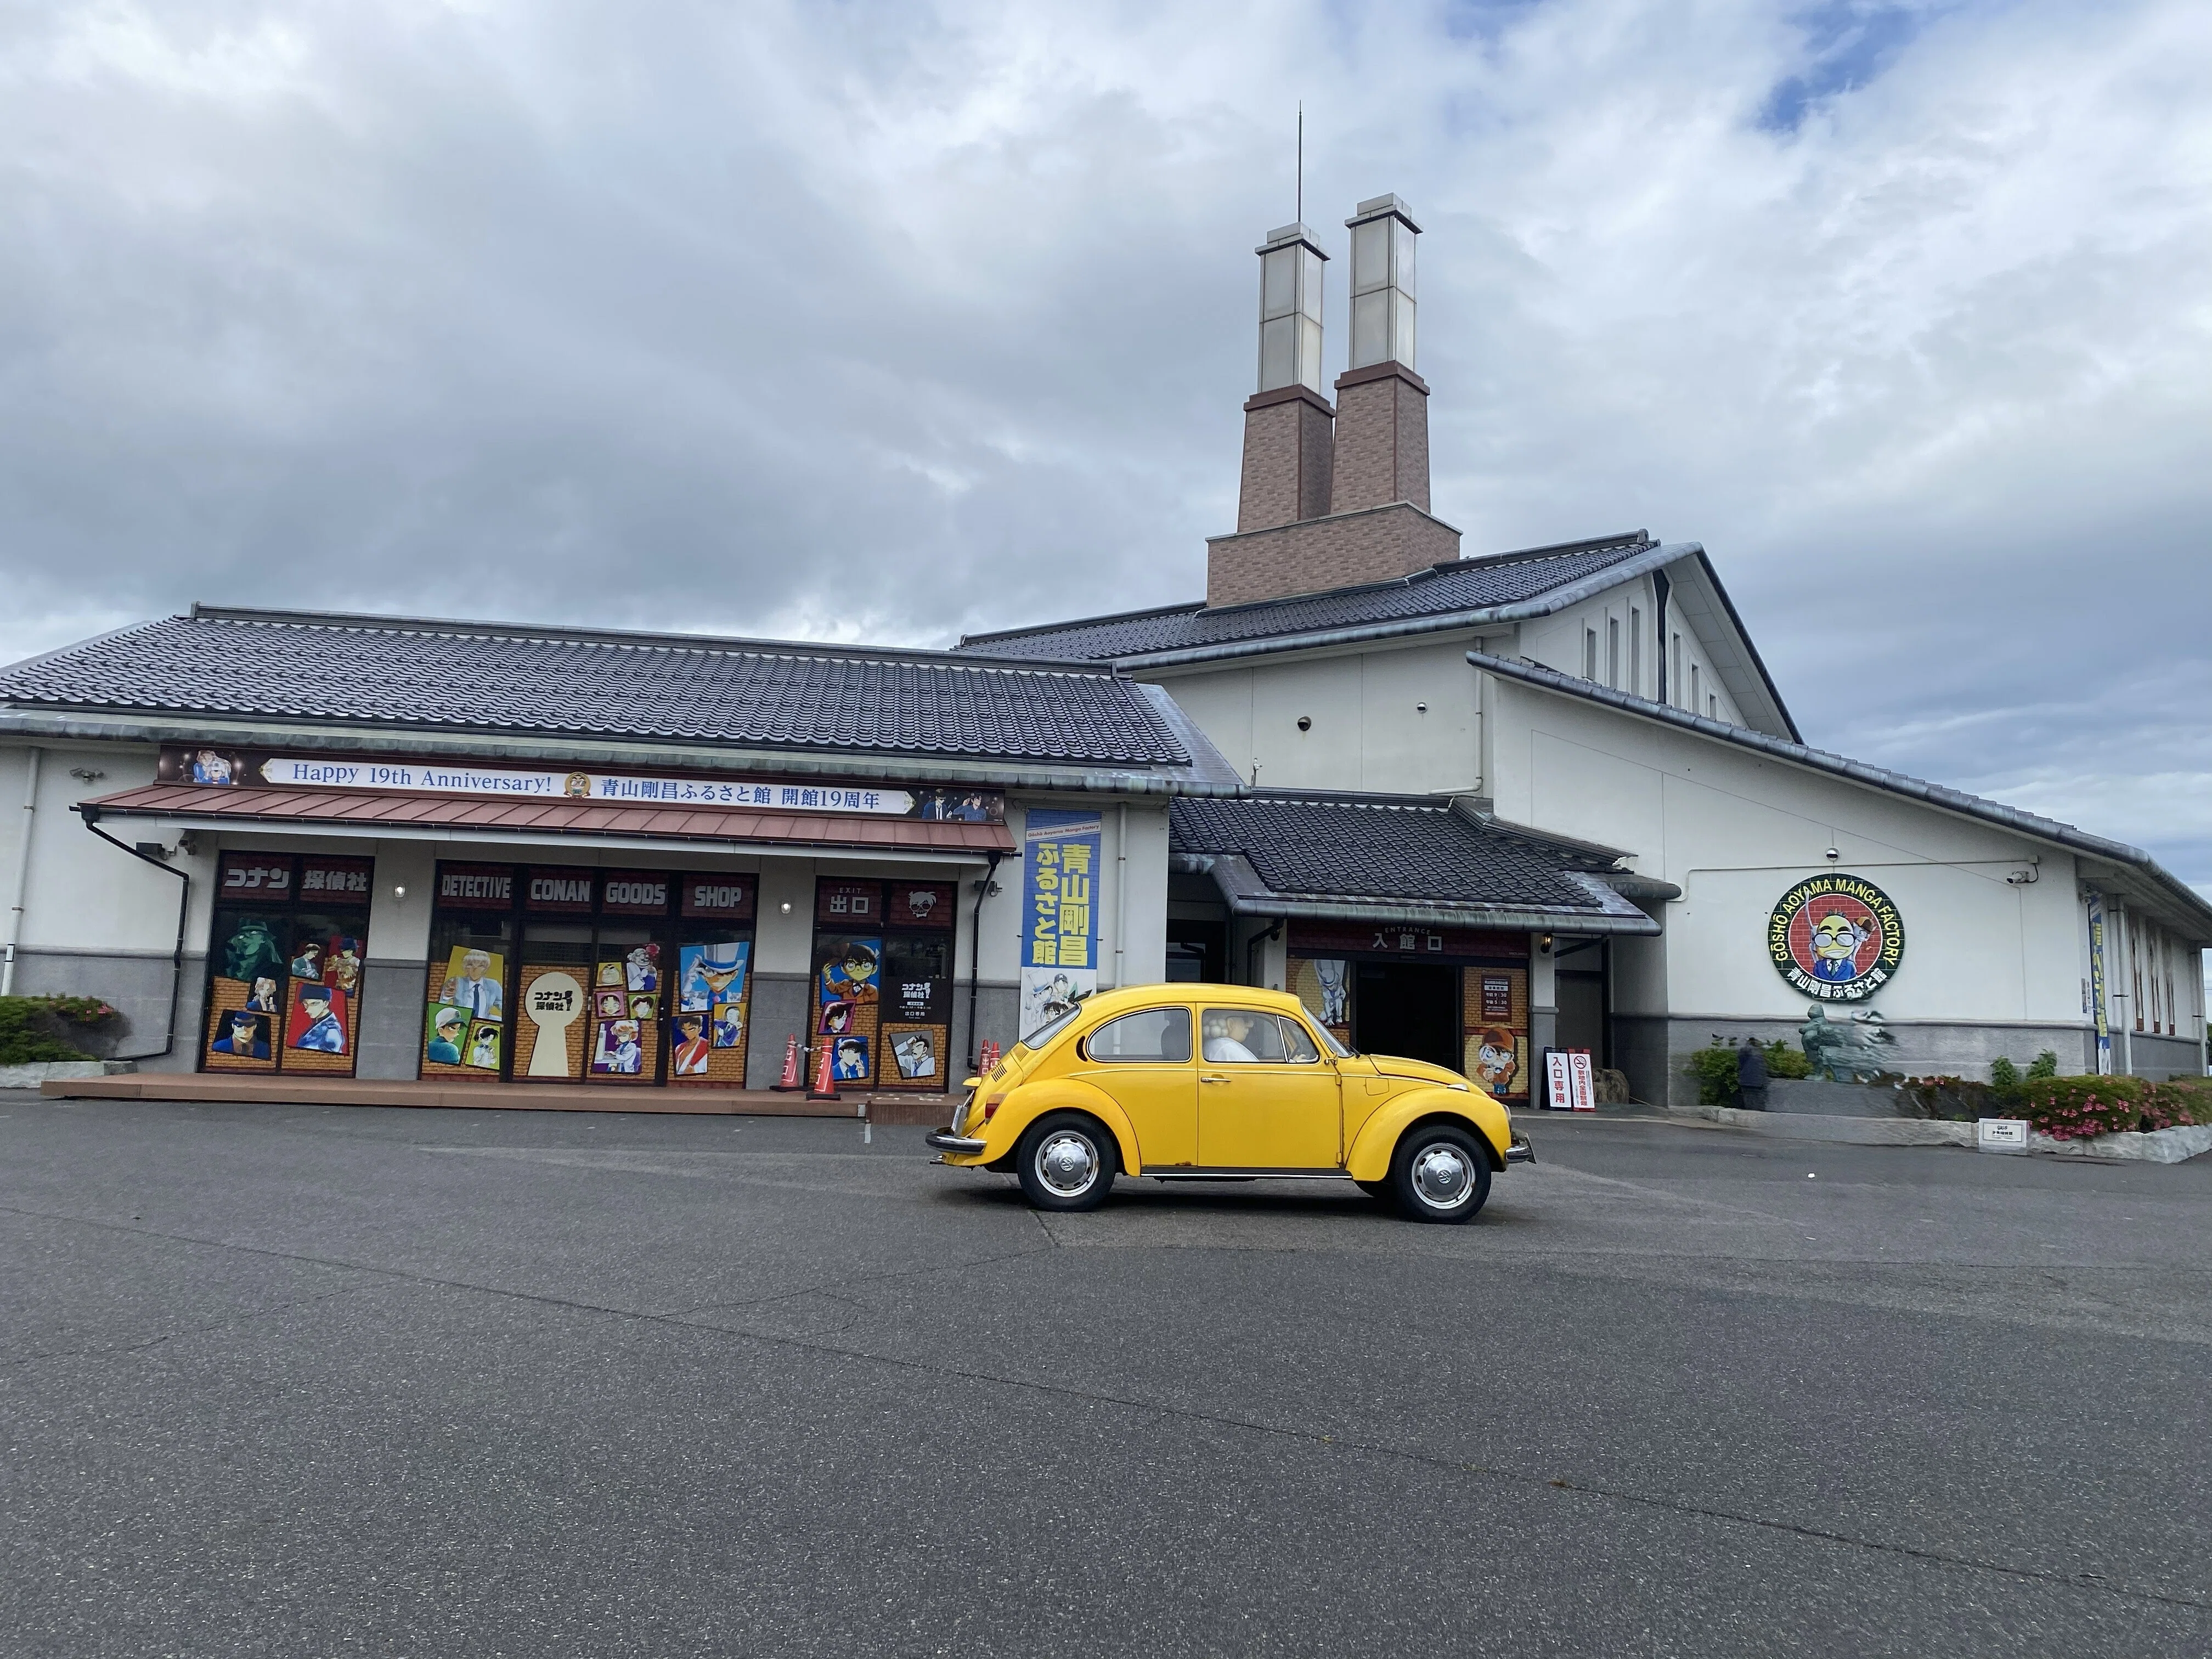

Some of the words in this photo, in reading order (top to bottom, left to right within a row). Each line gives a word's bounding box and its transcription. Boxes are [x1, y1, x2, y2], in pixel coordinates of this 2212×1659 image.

[294, 763, 359, 783] Happy
[370, 767, 411, 786] 19th
[421, 771, 551, 793] Anniversary!
[601, 778, 771, 805] 青山剛昌ふるさと館
[782, 787, 880, 809] 開館19周年
[224, 867, 289, 888] コナン
[302, 870, 367, 891] 探偵社
[441, 874, 511, 899] DETECTIVE
[531, 878, 590, 903] CONAN
[606, 881, 666, 906] GOODS
[694, 885, 742, 908] SHOP
[830, 895, 869, 913] 出口
[1032, 843, 1059, 965] ふるさと館
[1058, 843, 1091, 966] 青山剛昌
[1385, 927, 1431, 935] ENTRANCE
[1782, 879, 1832, 914] AOYAMA
[1835, 878, 1883, 909] MANGA
[1877, 905, 1900, 966] FACTORY
[1372, 933, 1442, 951] 入館口
[534, 991, 563, 1001] コナン
[901, 983, 923, 991] コナン
[1553, 1057, 1565, 1103] 入口専用
